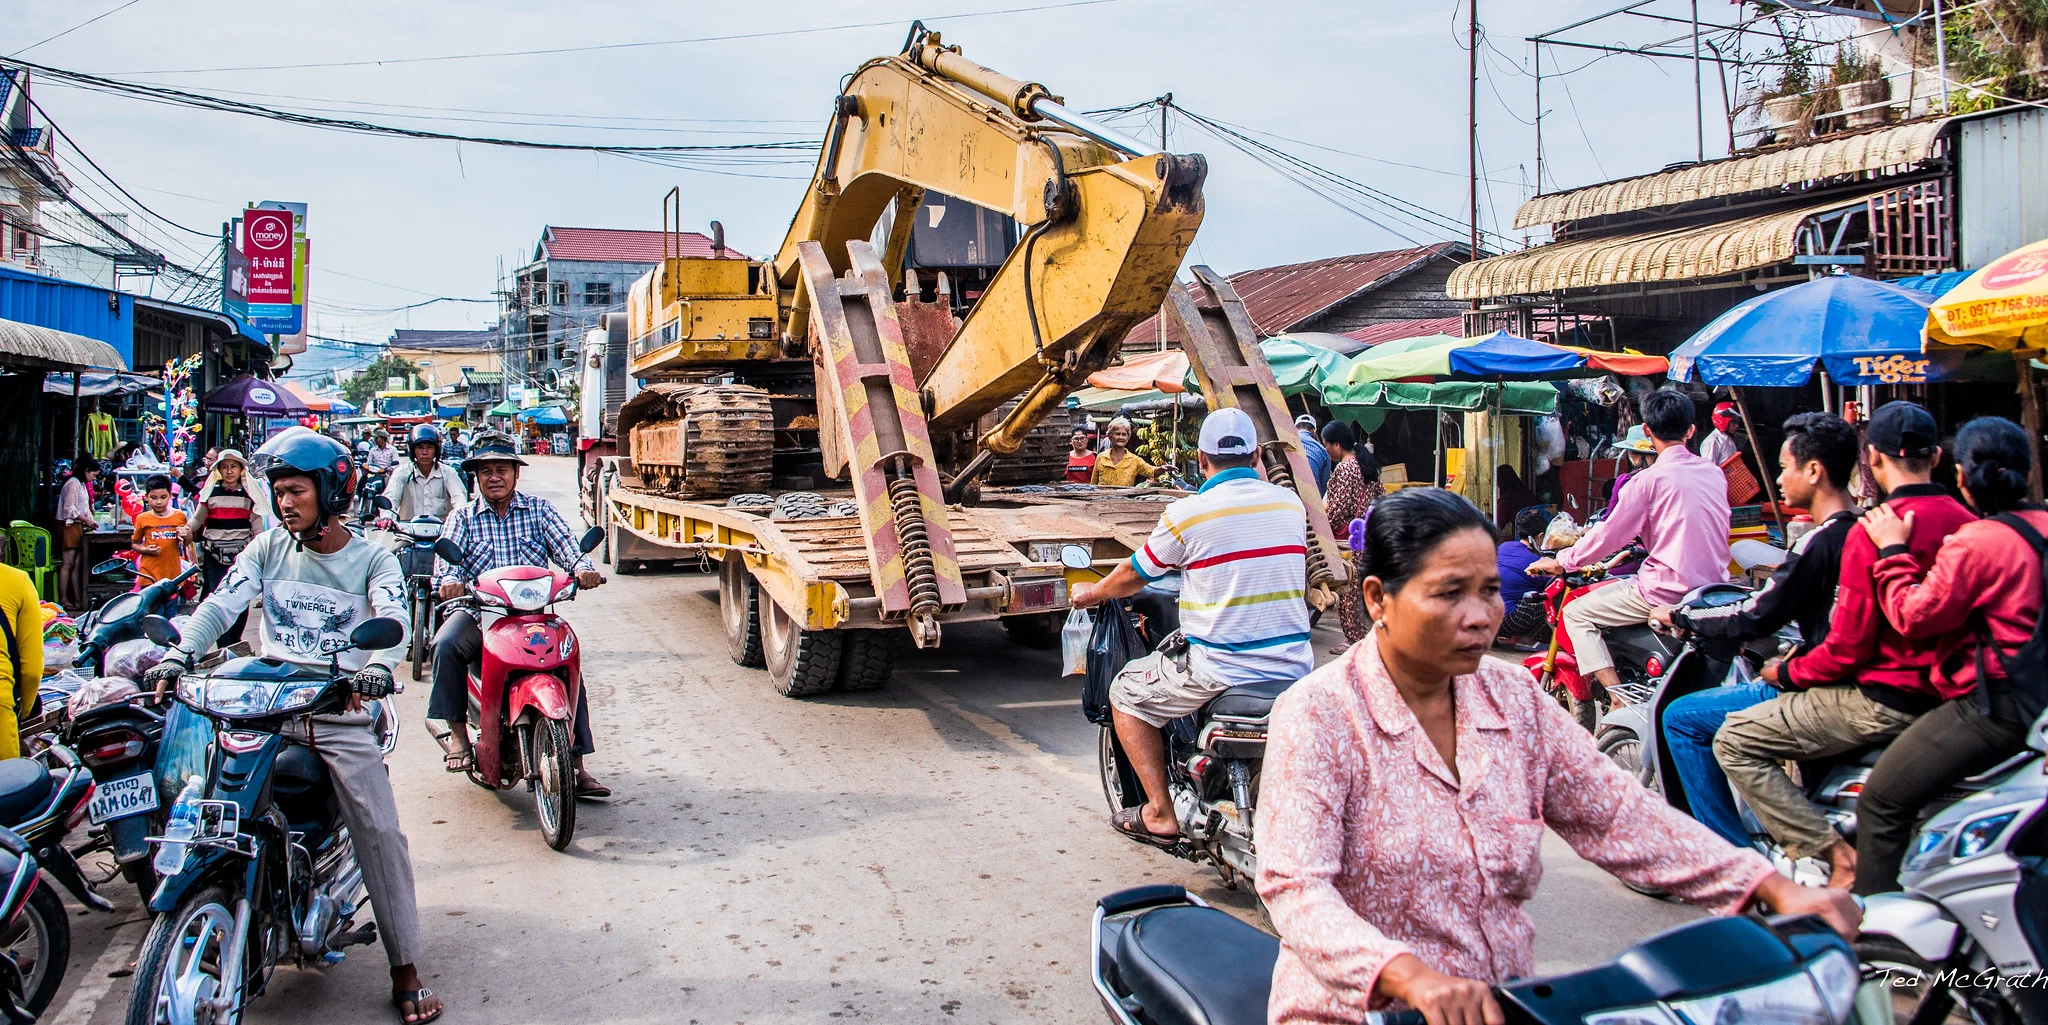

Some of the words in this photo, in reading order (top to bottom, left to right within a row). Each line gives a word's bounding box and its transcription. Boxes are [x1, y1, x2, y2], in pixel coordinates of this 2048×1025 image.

[255, 232, 283, 241] money
[1852, 354, 1930, 383] Tiger
[285, 599, 336, 615] TWINEAGLE
